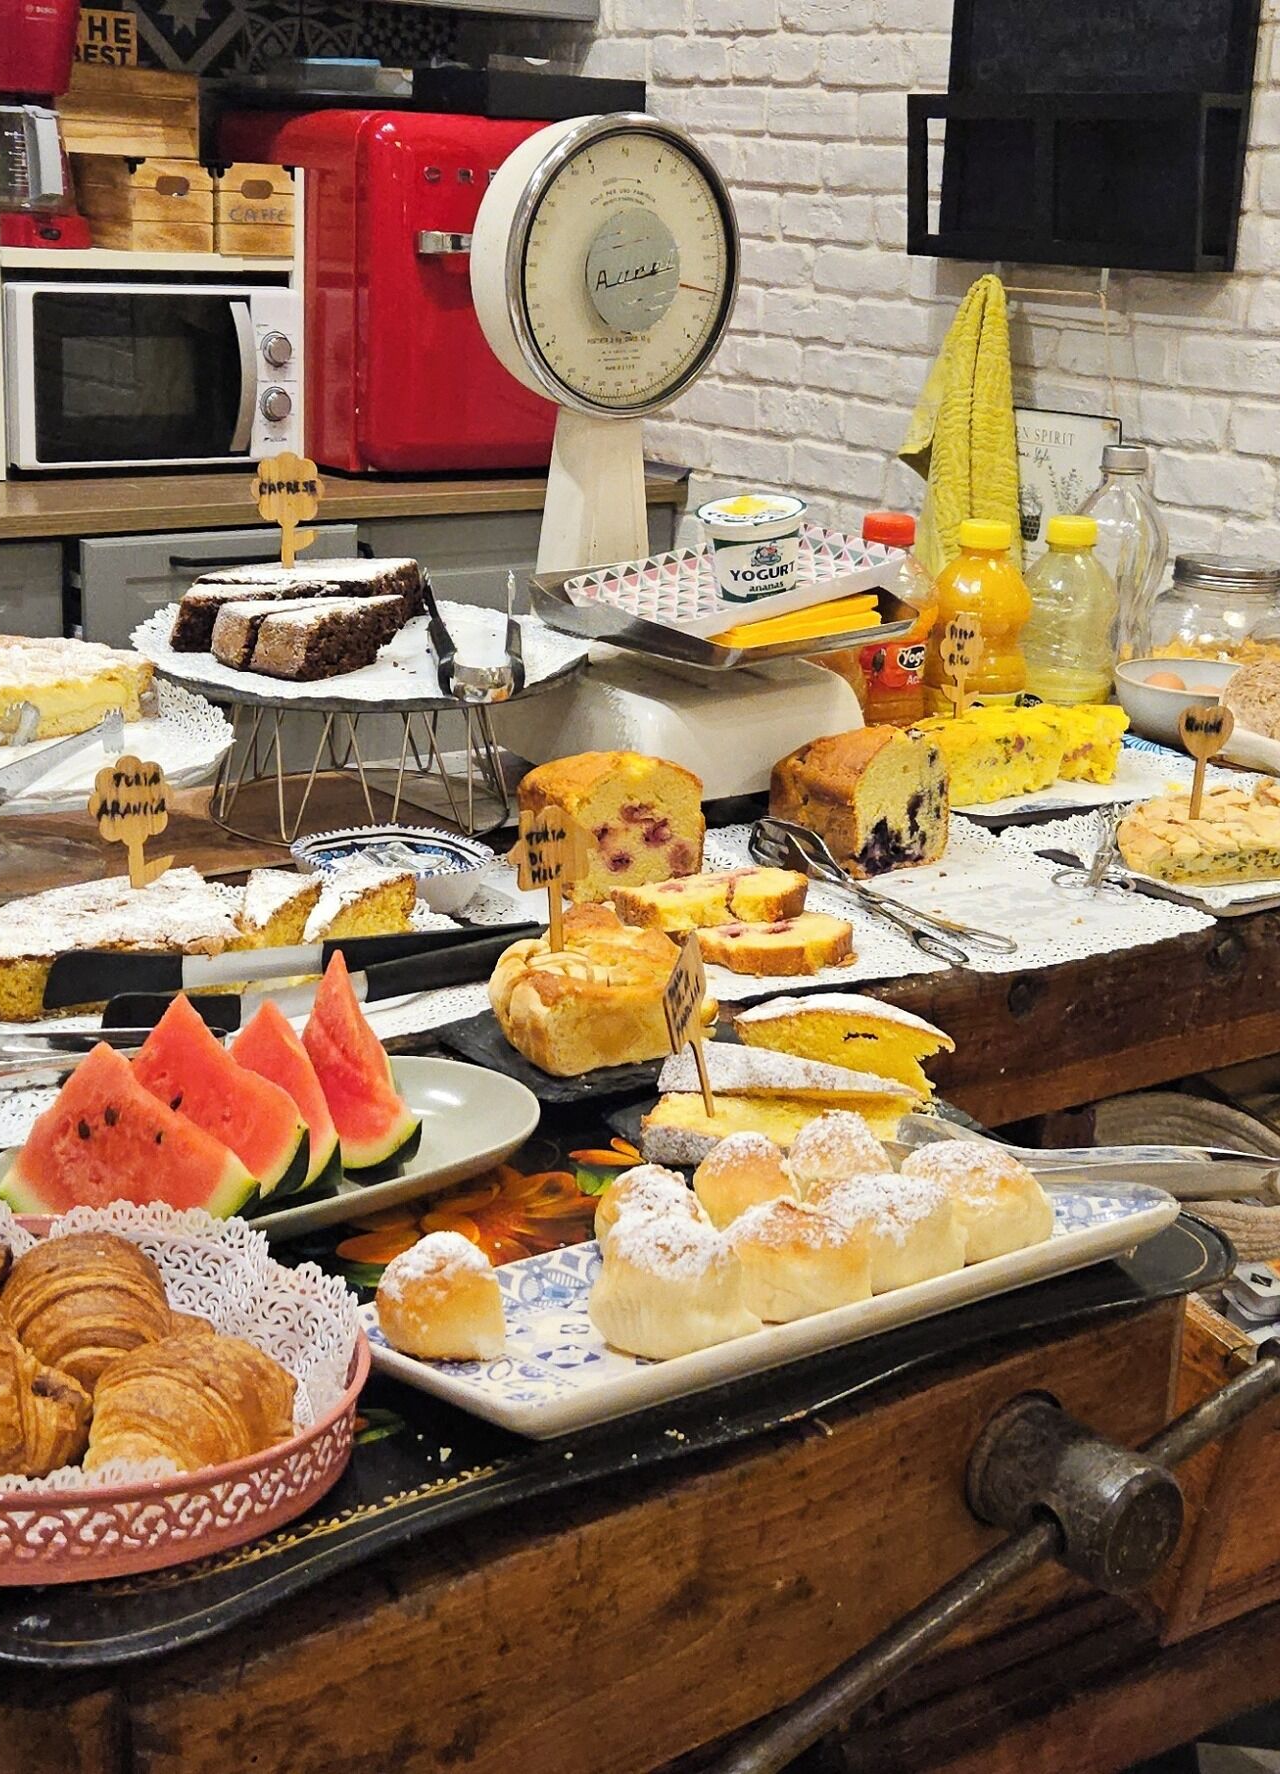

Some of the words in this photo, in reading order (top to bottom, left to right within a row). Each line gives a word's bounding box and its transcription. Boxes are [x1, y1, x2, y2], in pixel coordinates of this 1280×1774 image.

[79, 14, 131, 44] HE
[1034, 428, 1074, 447] SPIRIT
[729, 560, 796, 582] YOGURT
[749, 581, 785, 593] ananas
